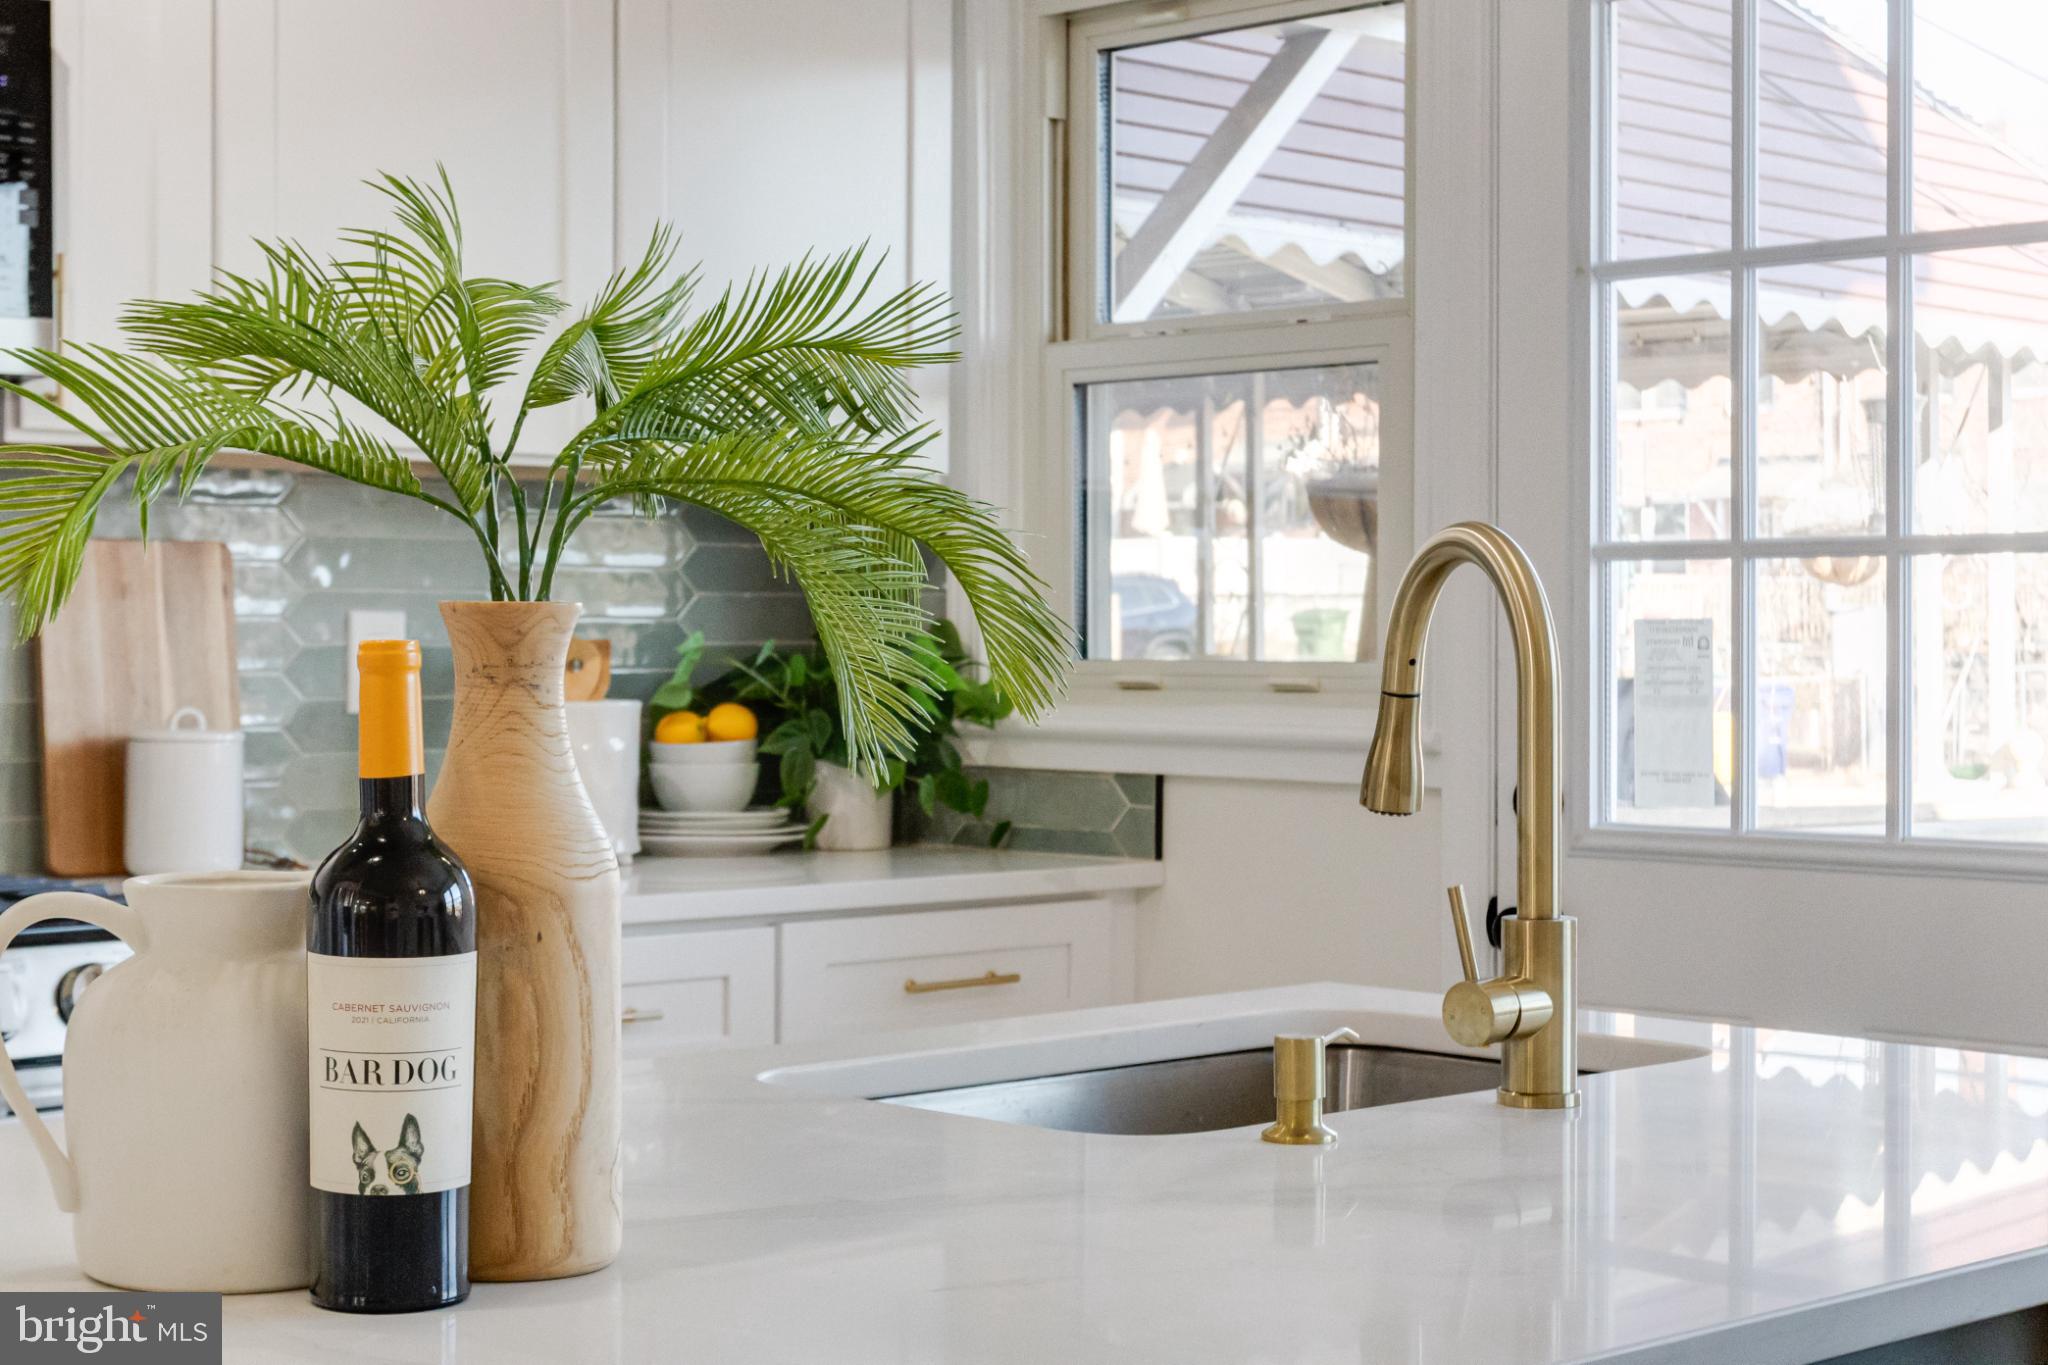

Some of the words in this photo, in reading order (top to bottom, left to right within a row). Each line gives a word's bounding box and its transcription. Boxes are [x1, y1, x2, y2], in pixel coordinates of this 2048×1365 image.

[331, 1002, 386, 1013] CABERNET
[388, 1002, 450, 1013] SAUVIGNON
[351, 1016, 369, 1024] 2021
[376, 1016, 430, 1025] CALIFORNIA
[324, 1055, 384, 1086] BAR
[392, 1054, 457, 1086] DOG
